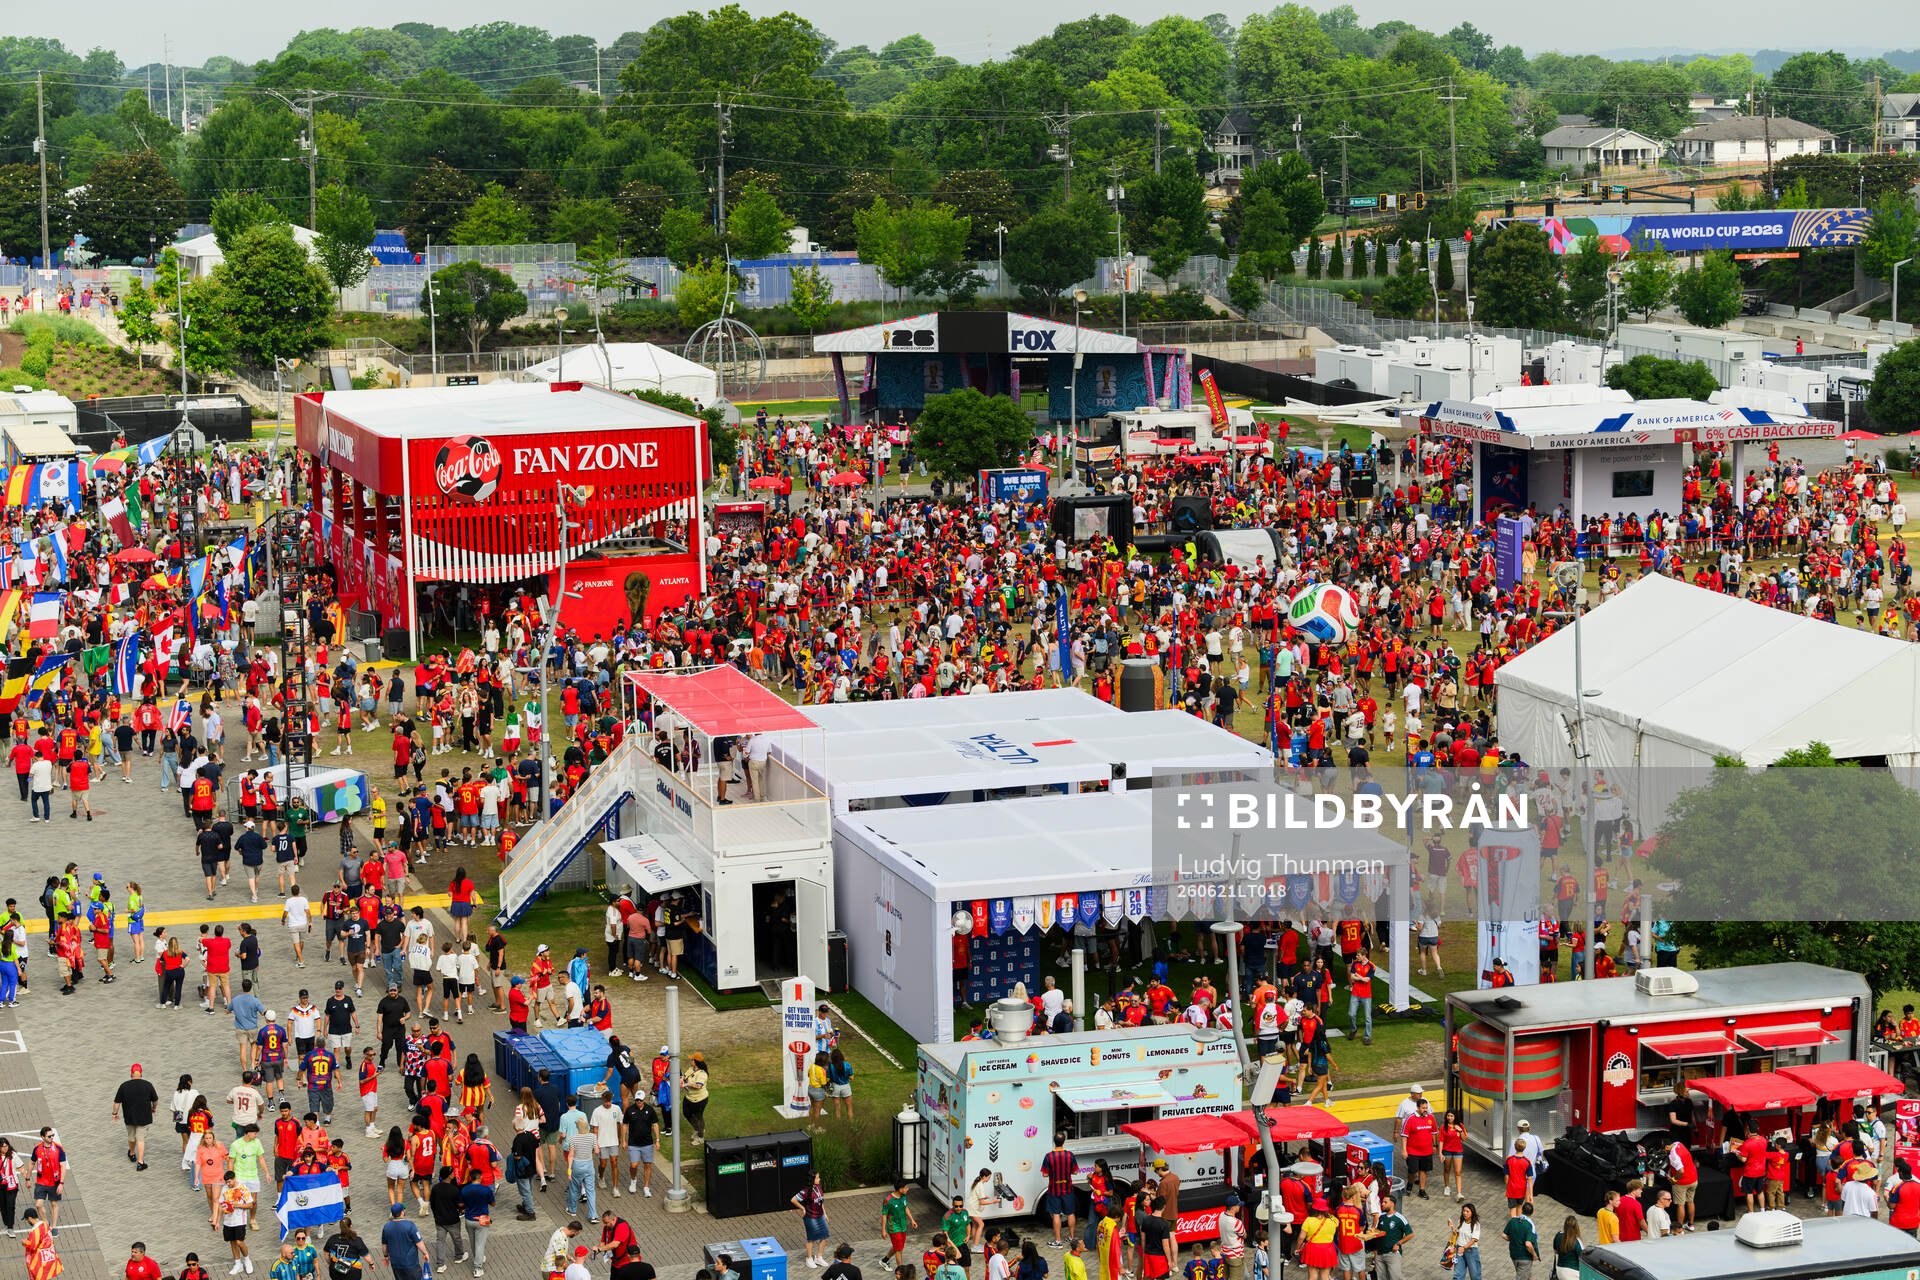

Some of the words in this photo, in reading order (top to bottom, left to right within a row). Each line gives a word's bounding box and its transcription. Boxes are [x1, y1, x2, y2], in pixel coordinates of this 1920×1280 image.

[1671, 227, 1713, 238] WORLD
[1716, 227, 1740, 237] CUP
[1742, 224, 1783, 236] 2026
[1011, 330, 1056, 351] FOX
[1097, 398, 1116, 407] FOX
[1443, 407, 1455, 415] BANK
[1462, 411, 1482, 420] AMERICA
[1637, 416, 1662, 425] BANK
[1663, 415, 1674, 424] OF
[1675, 414, 1715, 423] AMERICA
[1435, 422, 1444, 433] 6%
[1445, 424, 1461, 436] CASH
[1463, 427, 1479, 440] BACK
[1481, 431, 1501, 443] OFFER
[1706, 428, 1724, 440] 6%
[1727, 427, 1759, 439] CASH
[1762, 426, 1794, 438] BACK
[1797, 424, 1835, 436] OFFER
[1550, 439, 1574, 448] BANK
[1576, 438, 1588, 447] OF
[1590, 436, 1631, 446] AMERICA
[513, 446, 570, 475] FAN
[577, 442, 658, 471] ZONE
[436, 441, 502, 494] Coca-Cola
[660, 577, 689, 585] ATLANTA
[65, 736, 75, 747] 19
[970, 734, 1039, 764] ULTRA
[198, 785, 210, 796] 20
[462, 791, 471, 802] 19
[676, 794, 692, 818] ULTRA
[279, 840, 288, 851] 10
[504, 839, 513, 850] 19
[645, 864, 671, 881] ULTRA
[1132, 873, 1171, 885] Michelob
[1597, 876, 1606, 889] 19
[1129, 890, 1141, 903] 20
[1130, 904, 1141, 915] 26
[1346, 927, 1357, 941] 19
[412, 945, 427, 956] USA
[269, 1035, 277, 1049] 8
[1207, 1043, 1232, 1051] LATTES
[1102, 1053, 1131, 1061] DONUTS
[1146, 1047, 1189, 1057] LEMONADES
[991, 1063, 1018, 1071] CREAM
[1041, 1058, 1069, 1067] SHAVED
[1069, 1056, 1081, 1064] ICE
[313, 1061, 328, 1075] 10
[238, 1097, 249, 1110] 19
[1162, 1107, 1195, 1117] PRIVATE
[1195, 1104, 1235, 1114] CATERING
[193, 1122, 204, 1133] 19
[974, 1121, 997, 1129] FLAVOR
[1198, 1143, 1215, 1151] Coca-Cola
[1176, 1213, 1219, 1234] Coca-Cola
[1341, 1219, 1355, 1236] 19
